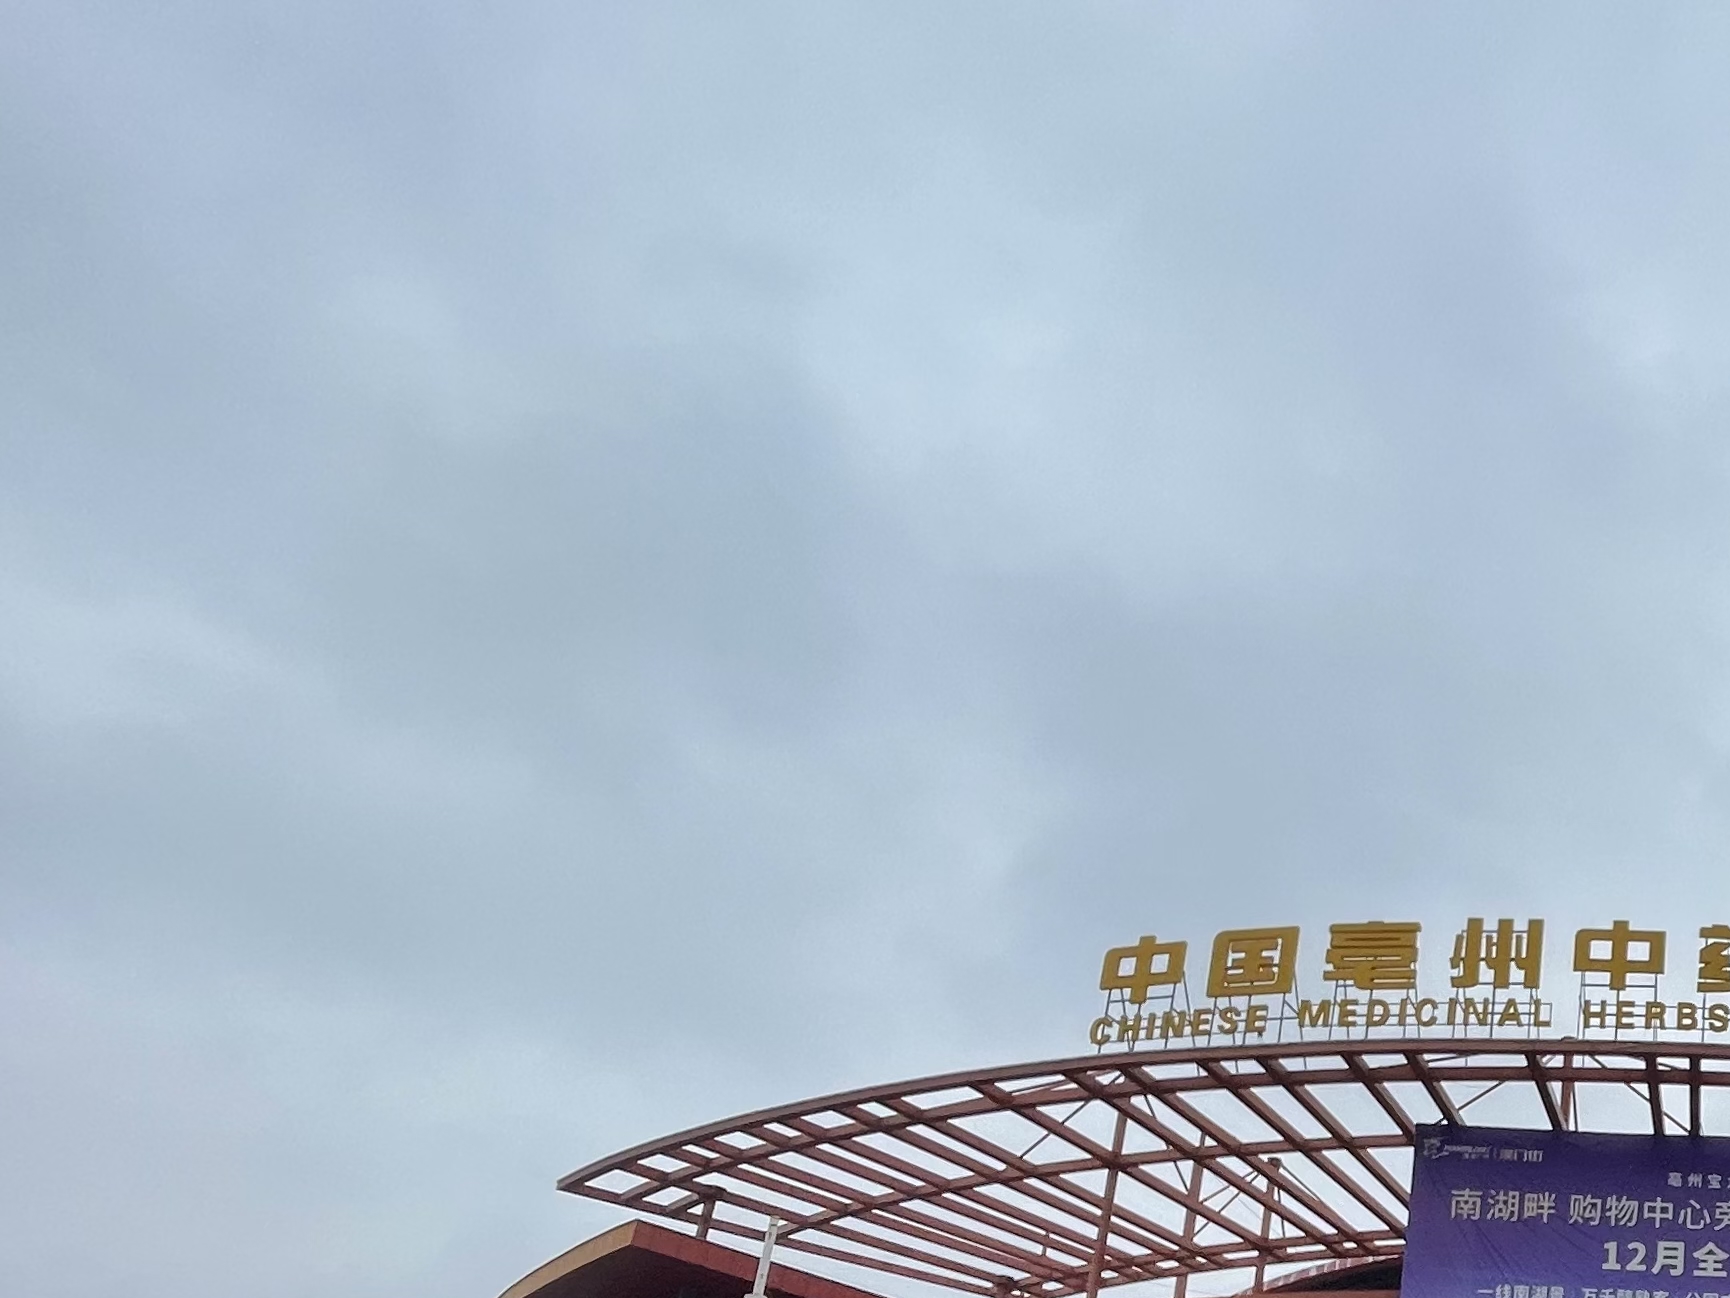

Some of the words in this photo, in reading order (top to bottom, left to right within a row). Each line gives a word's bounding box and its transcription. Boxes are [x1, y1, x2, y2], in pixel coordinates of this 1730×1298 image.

[1090, 1005, 1269, 1044] CHINESE
[1299, 998, 1552, 1029] MEDICINAL
[1583, 1000, 1730, 1033] HERBS
[1450, 1188, 1556, 1224] 南湖畔
